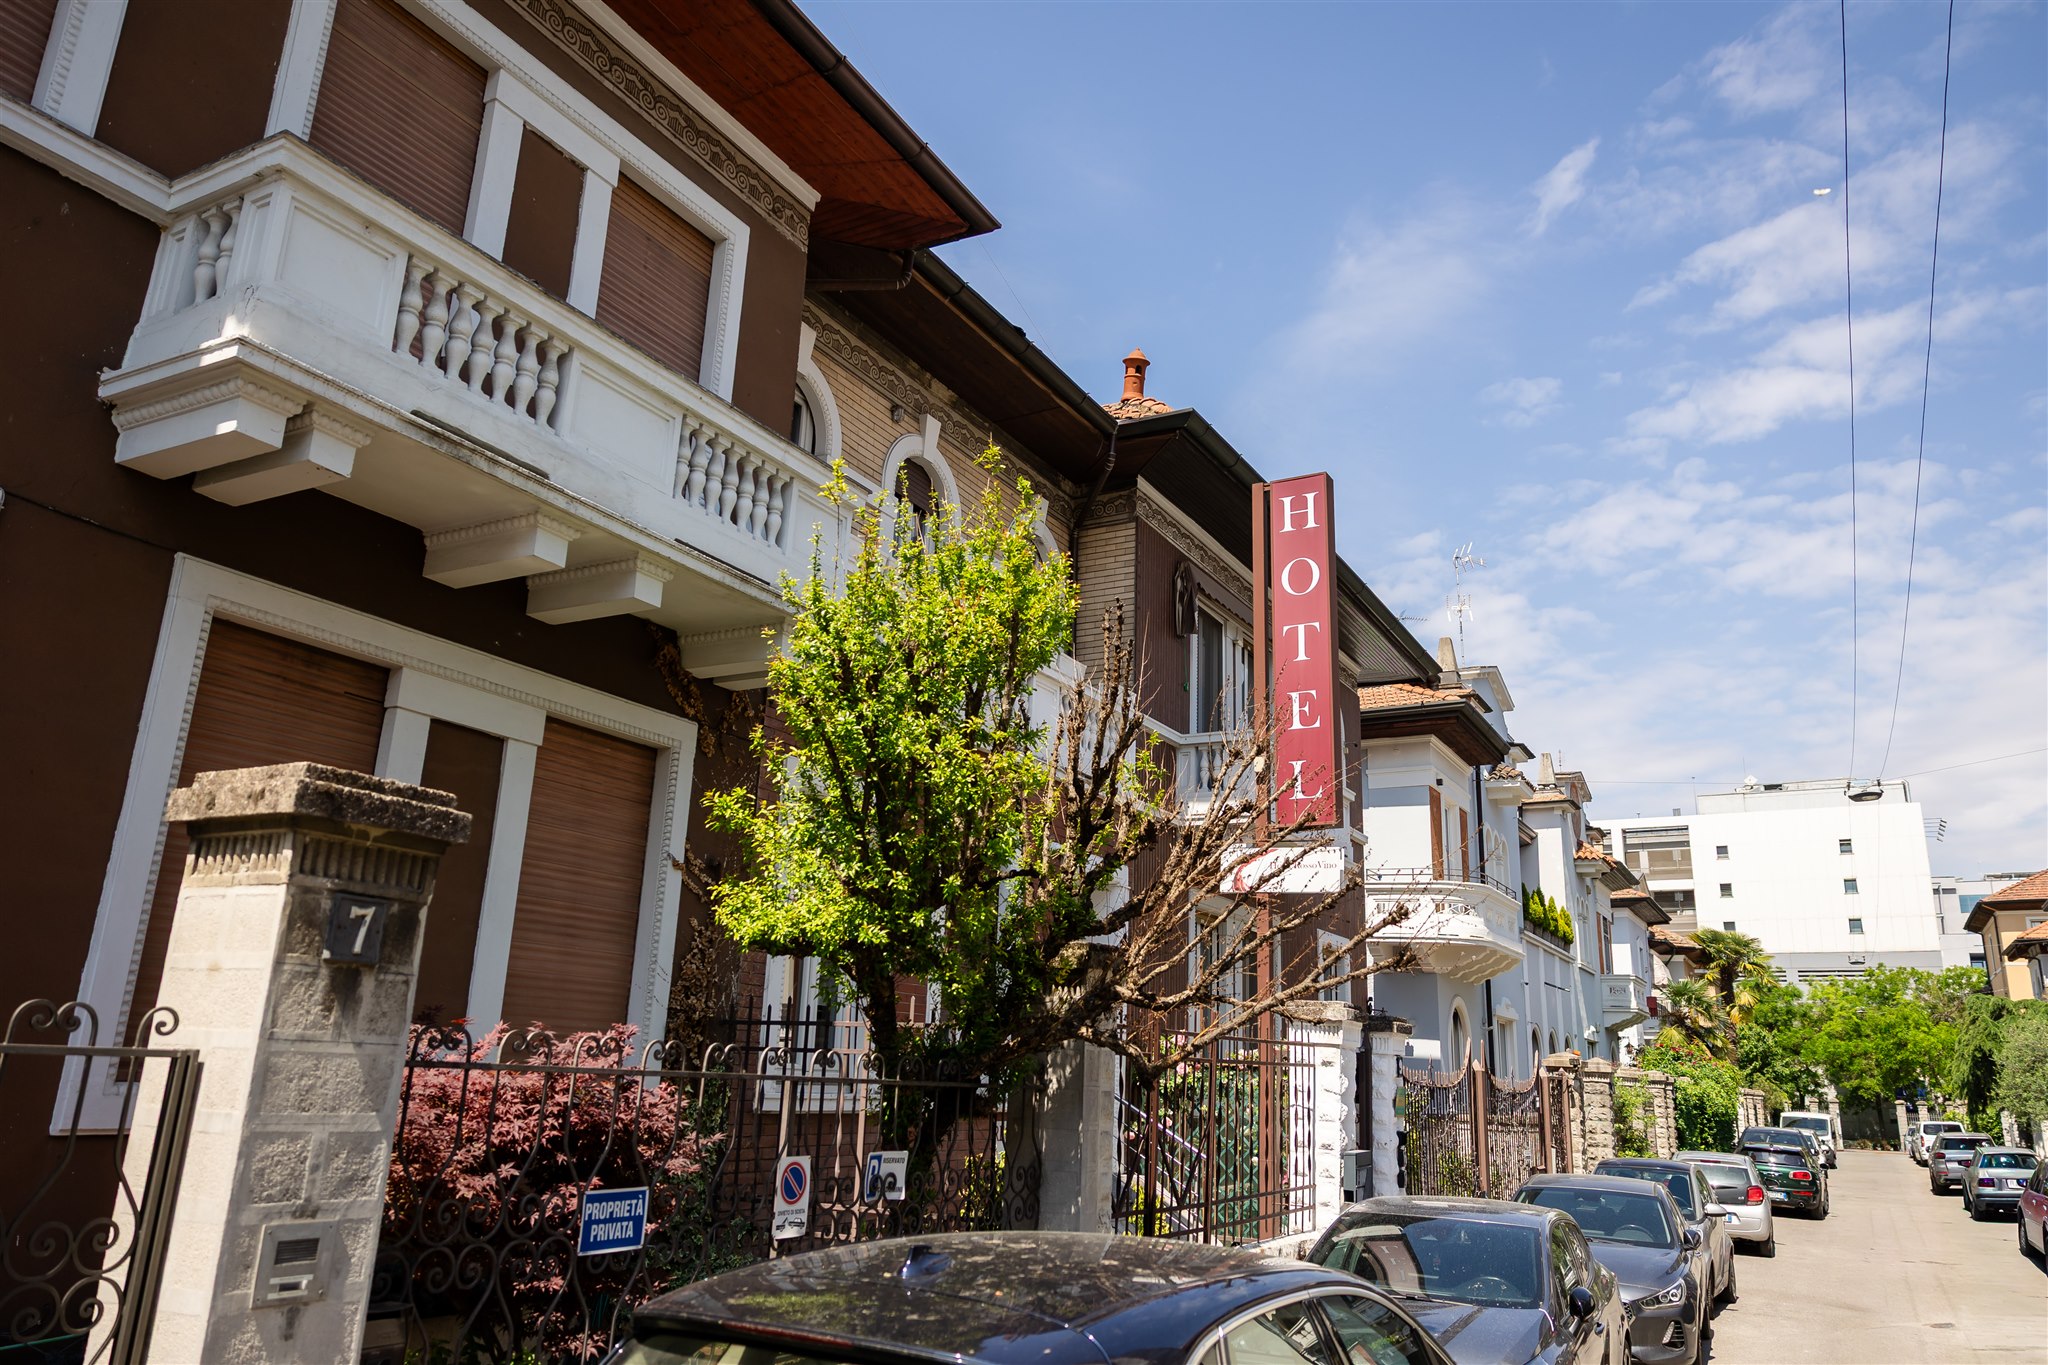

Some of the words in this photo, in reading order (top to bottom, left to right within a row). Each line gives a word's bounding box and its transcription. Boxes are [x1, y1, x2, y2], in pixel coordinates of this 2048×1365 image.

[1278, 491, 1323, 800] HOTEL
[350, 906, 376, 954] 7
[585, 1194, 643, 1221] PROPRIETÀ
[590, 1221, 633, 1242] PRIVATA
